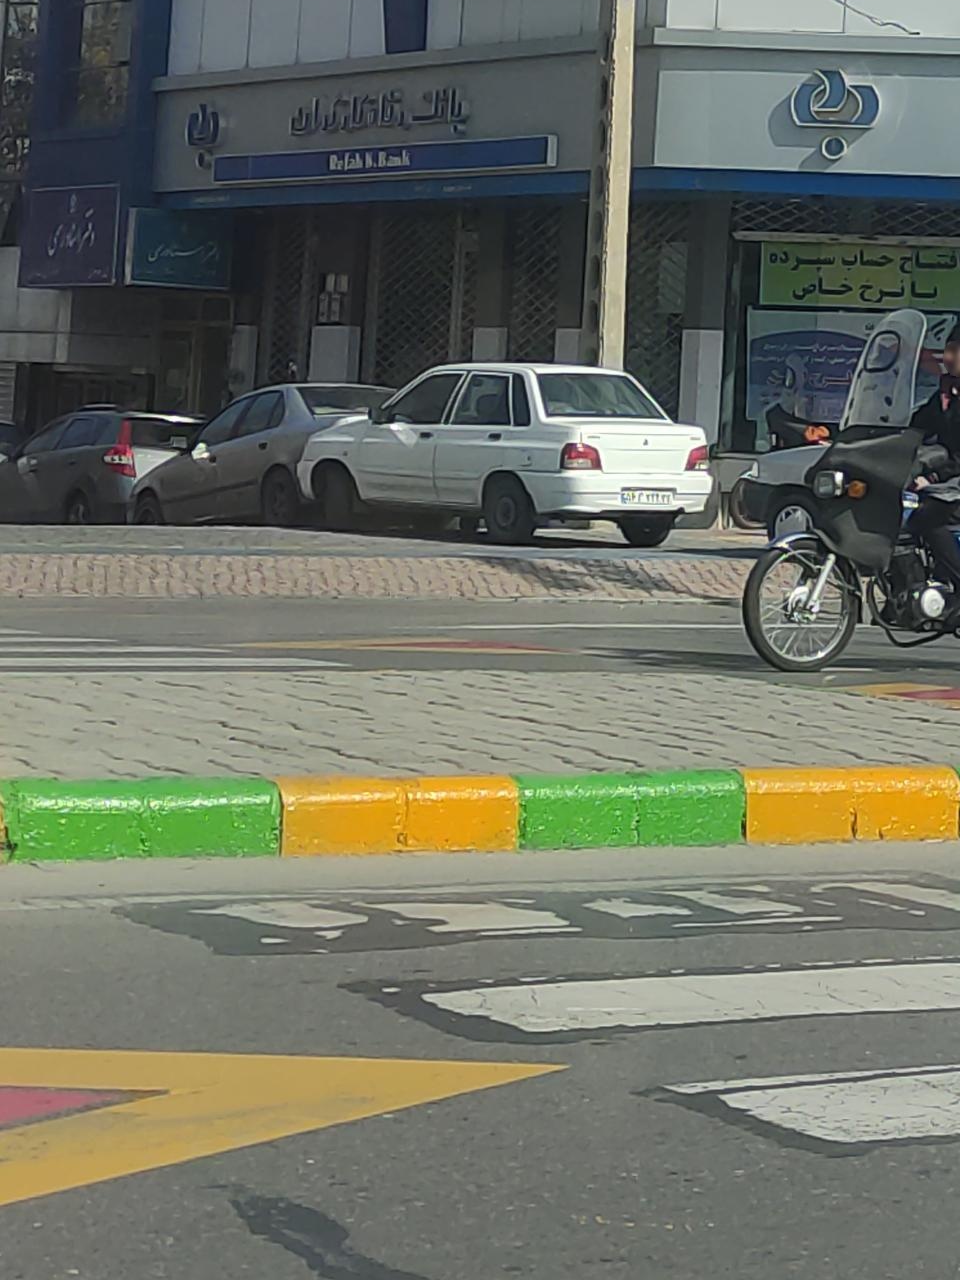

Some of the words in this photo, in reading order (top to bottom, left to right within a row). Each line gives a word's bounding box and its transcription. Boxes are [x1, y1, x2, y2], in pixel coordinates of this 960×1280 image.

[412, 87, 470, 135] بانک
[329, 153, 363, 171] Refah
[378, 150, 411, 168] Bank
[769, 250, 836, 272] سپرده
[841, 249, 894, 268] حساب
[792, 276, 854, 301] خاص
[859, 277, 905, 303] نرخ
[910, 280, 938, 300] با
